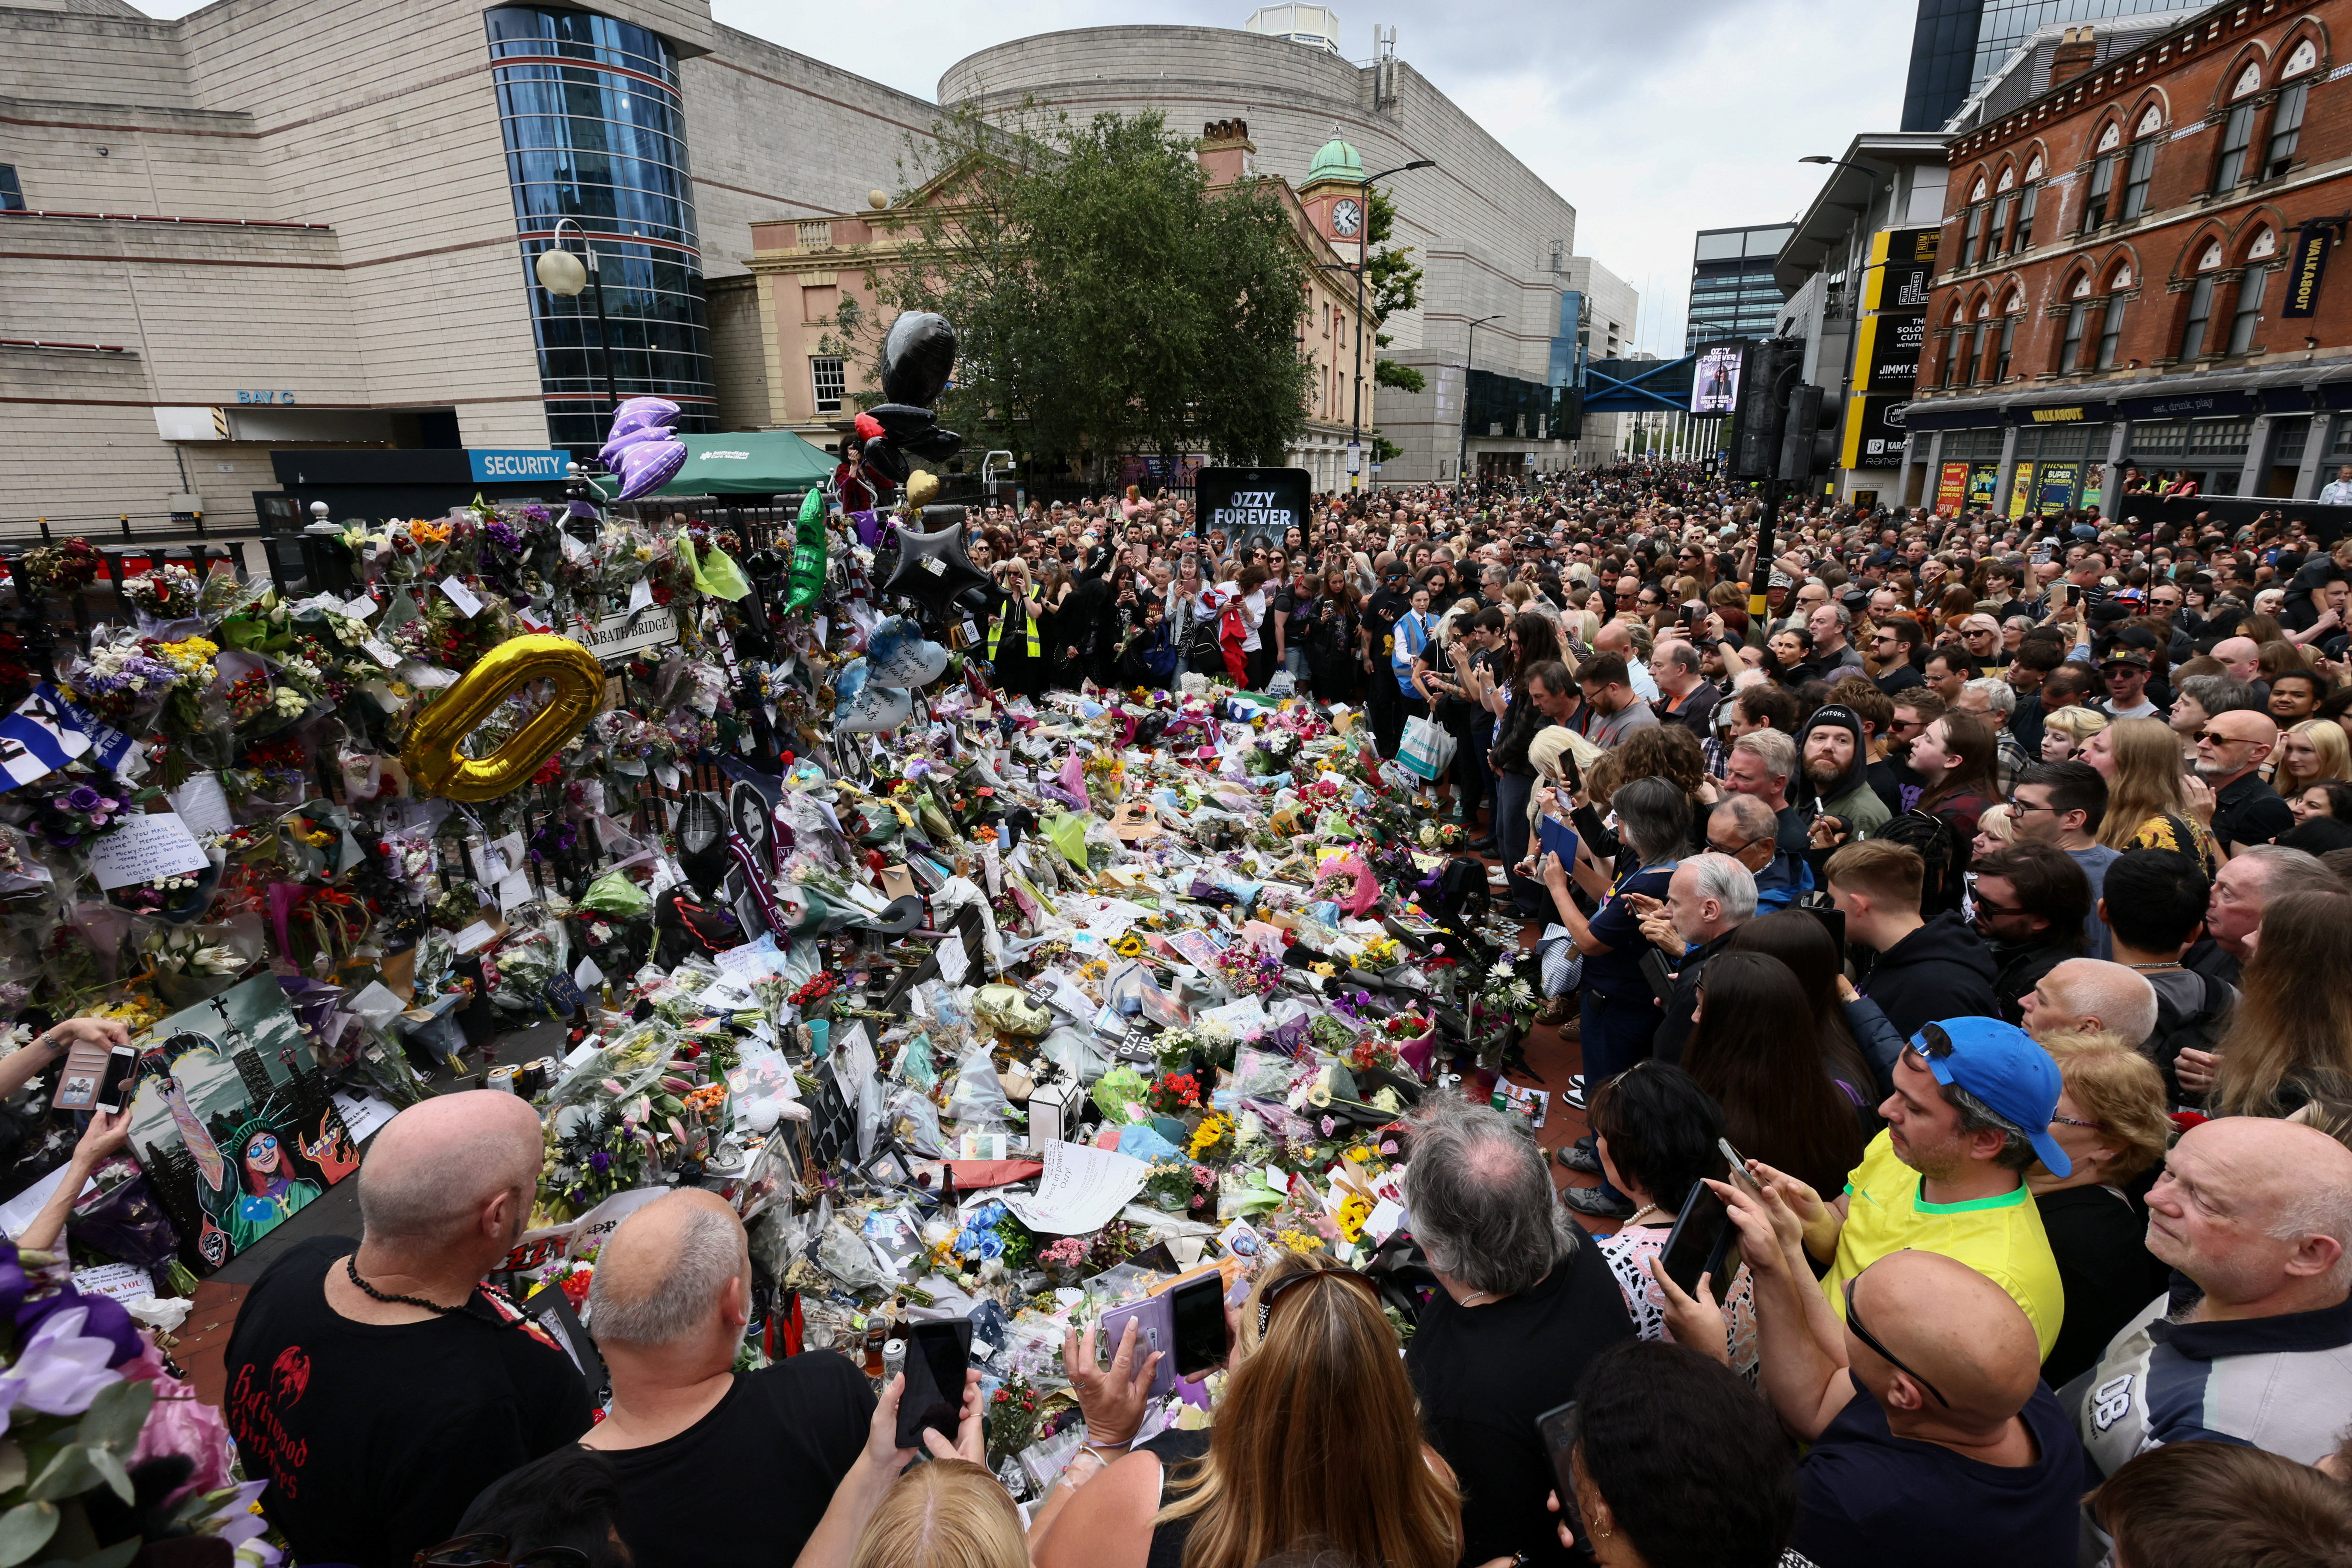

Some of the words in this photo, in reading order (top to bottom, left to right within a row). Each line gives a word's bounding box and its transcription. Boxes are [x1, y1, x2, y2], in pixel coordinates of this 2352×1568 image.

[2295, 237, 2323, 310] WALKABOUT
[1911, 274, 1921, 301] RUNNER
[1703, 354, 1736, 362] FOREVER
[1879, 364, 1910, 374] JIMMY
[237, 390, 273, 404] BAY
[280, 391, 294, 404] C
[2153, 405, 2168, 413] eat,
[2169, 402, 2194, 411] drink,
[2196, 399, 2214, 409] play
[2032, 408, 2083, 422] WALKABOUT
[485, 455, 559, 475] SECURITY
[2048, 470, 2071, 478] SUPER
[1231, 491, 1276, 508] OZZY
[1938, 504, 1954, 513] SPORT
[1214, 508, 1291, 525] FOREVER
[632, 617, 668, 637] BRIDGE
[897, 641, 930, 672] Forever
[897, 657, 905, 666] in
[904, 664, 917, 675] our
[881, 659, 913, 684] Hearts
[104, 730, 124, 749] BLUES
[1409, 735, 1440, 755] Poundland
[96, 835, 129, 845] MAMA
[133, 831, 149, 840] YOU
[151, 826, 168, 834] MADE
[139, 835, 169, 845] MEMORIES
[126, 867, 151, 877] HOLTE
[159, 867, 181, 876] BLESS
[1030, 985, 1053, 1004] BLACK
[1119, 1027, 1141, 1055] OZZY
[306, 1128, 339, 1157] OZZY
[1060, 1167, 1072, 1189] Ozzy!
[1121, 1166, 1131, 1185] prayers
[1129, 1168, 1142, 1189] SOCIETY
[1045, 1183, 1057, 1199] Rest
[121, 1279, 145, 1290] YOU!
[2095, 1373, 2135, 1432] 08
